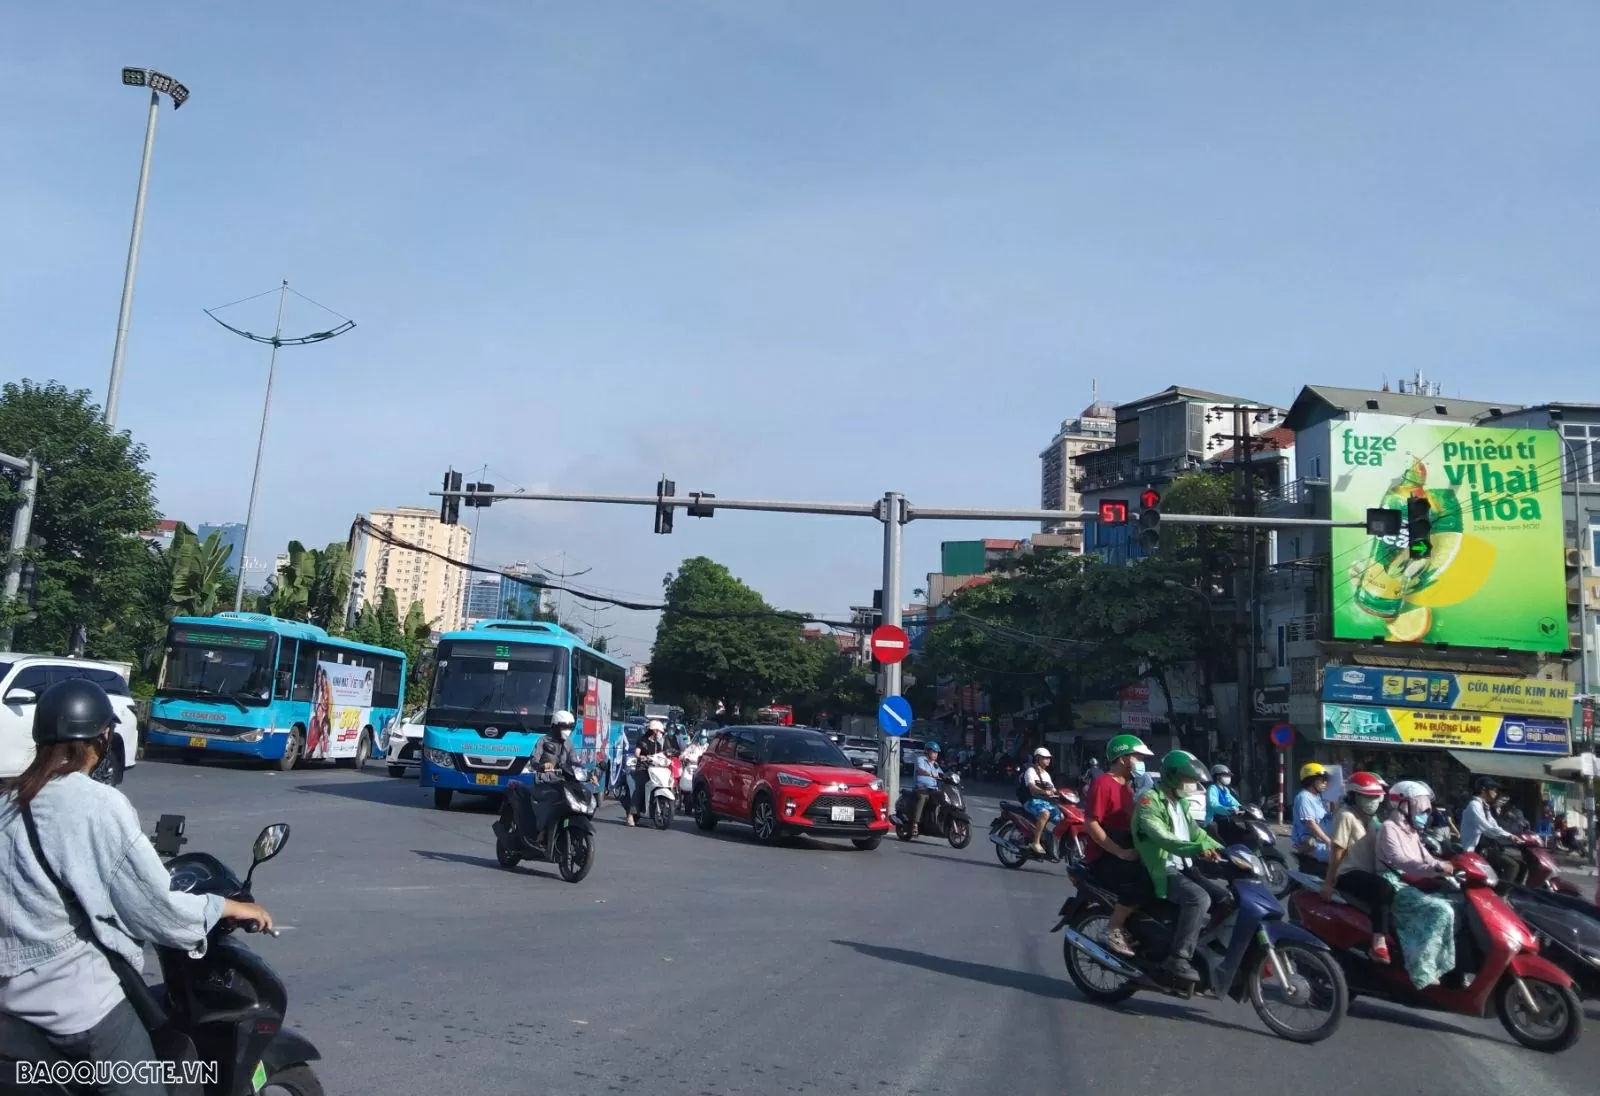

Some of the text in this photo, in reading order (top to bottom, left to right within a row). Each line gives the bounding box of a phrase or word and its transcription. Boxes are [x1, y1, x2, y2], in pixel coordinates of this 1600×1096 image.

[1342, 428, 1397, 452] fuze
[1342, 448, 1383, 467] tea
[1481, 463, 1540, 494] hài
[1103, 503, 1126, 522] 57
[1467, 679, 1569, 699] CỬA HÀNG KIM KHÍ
